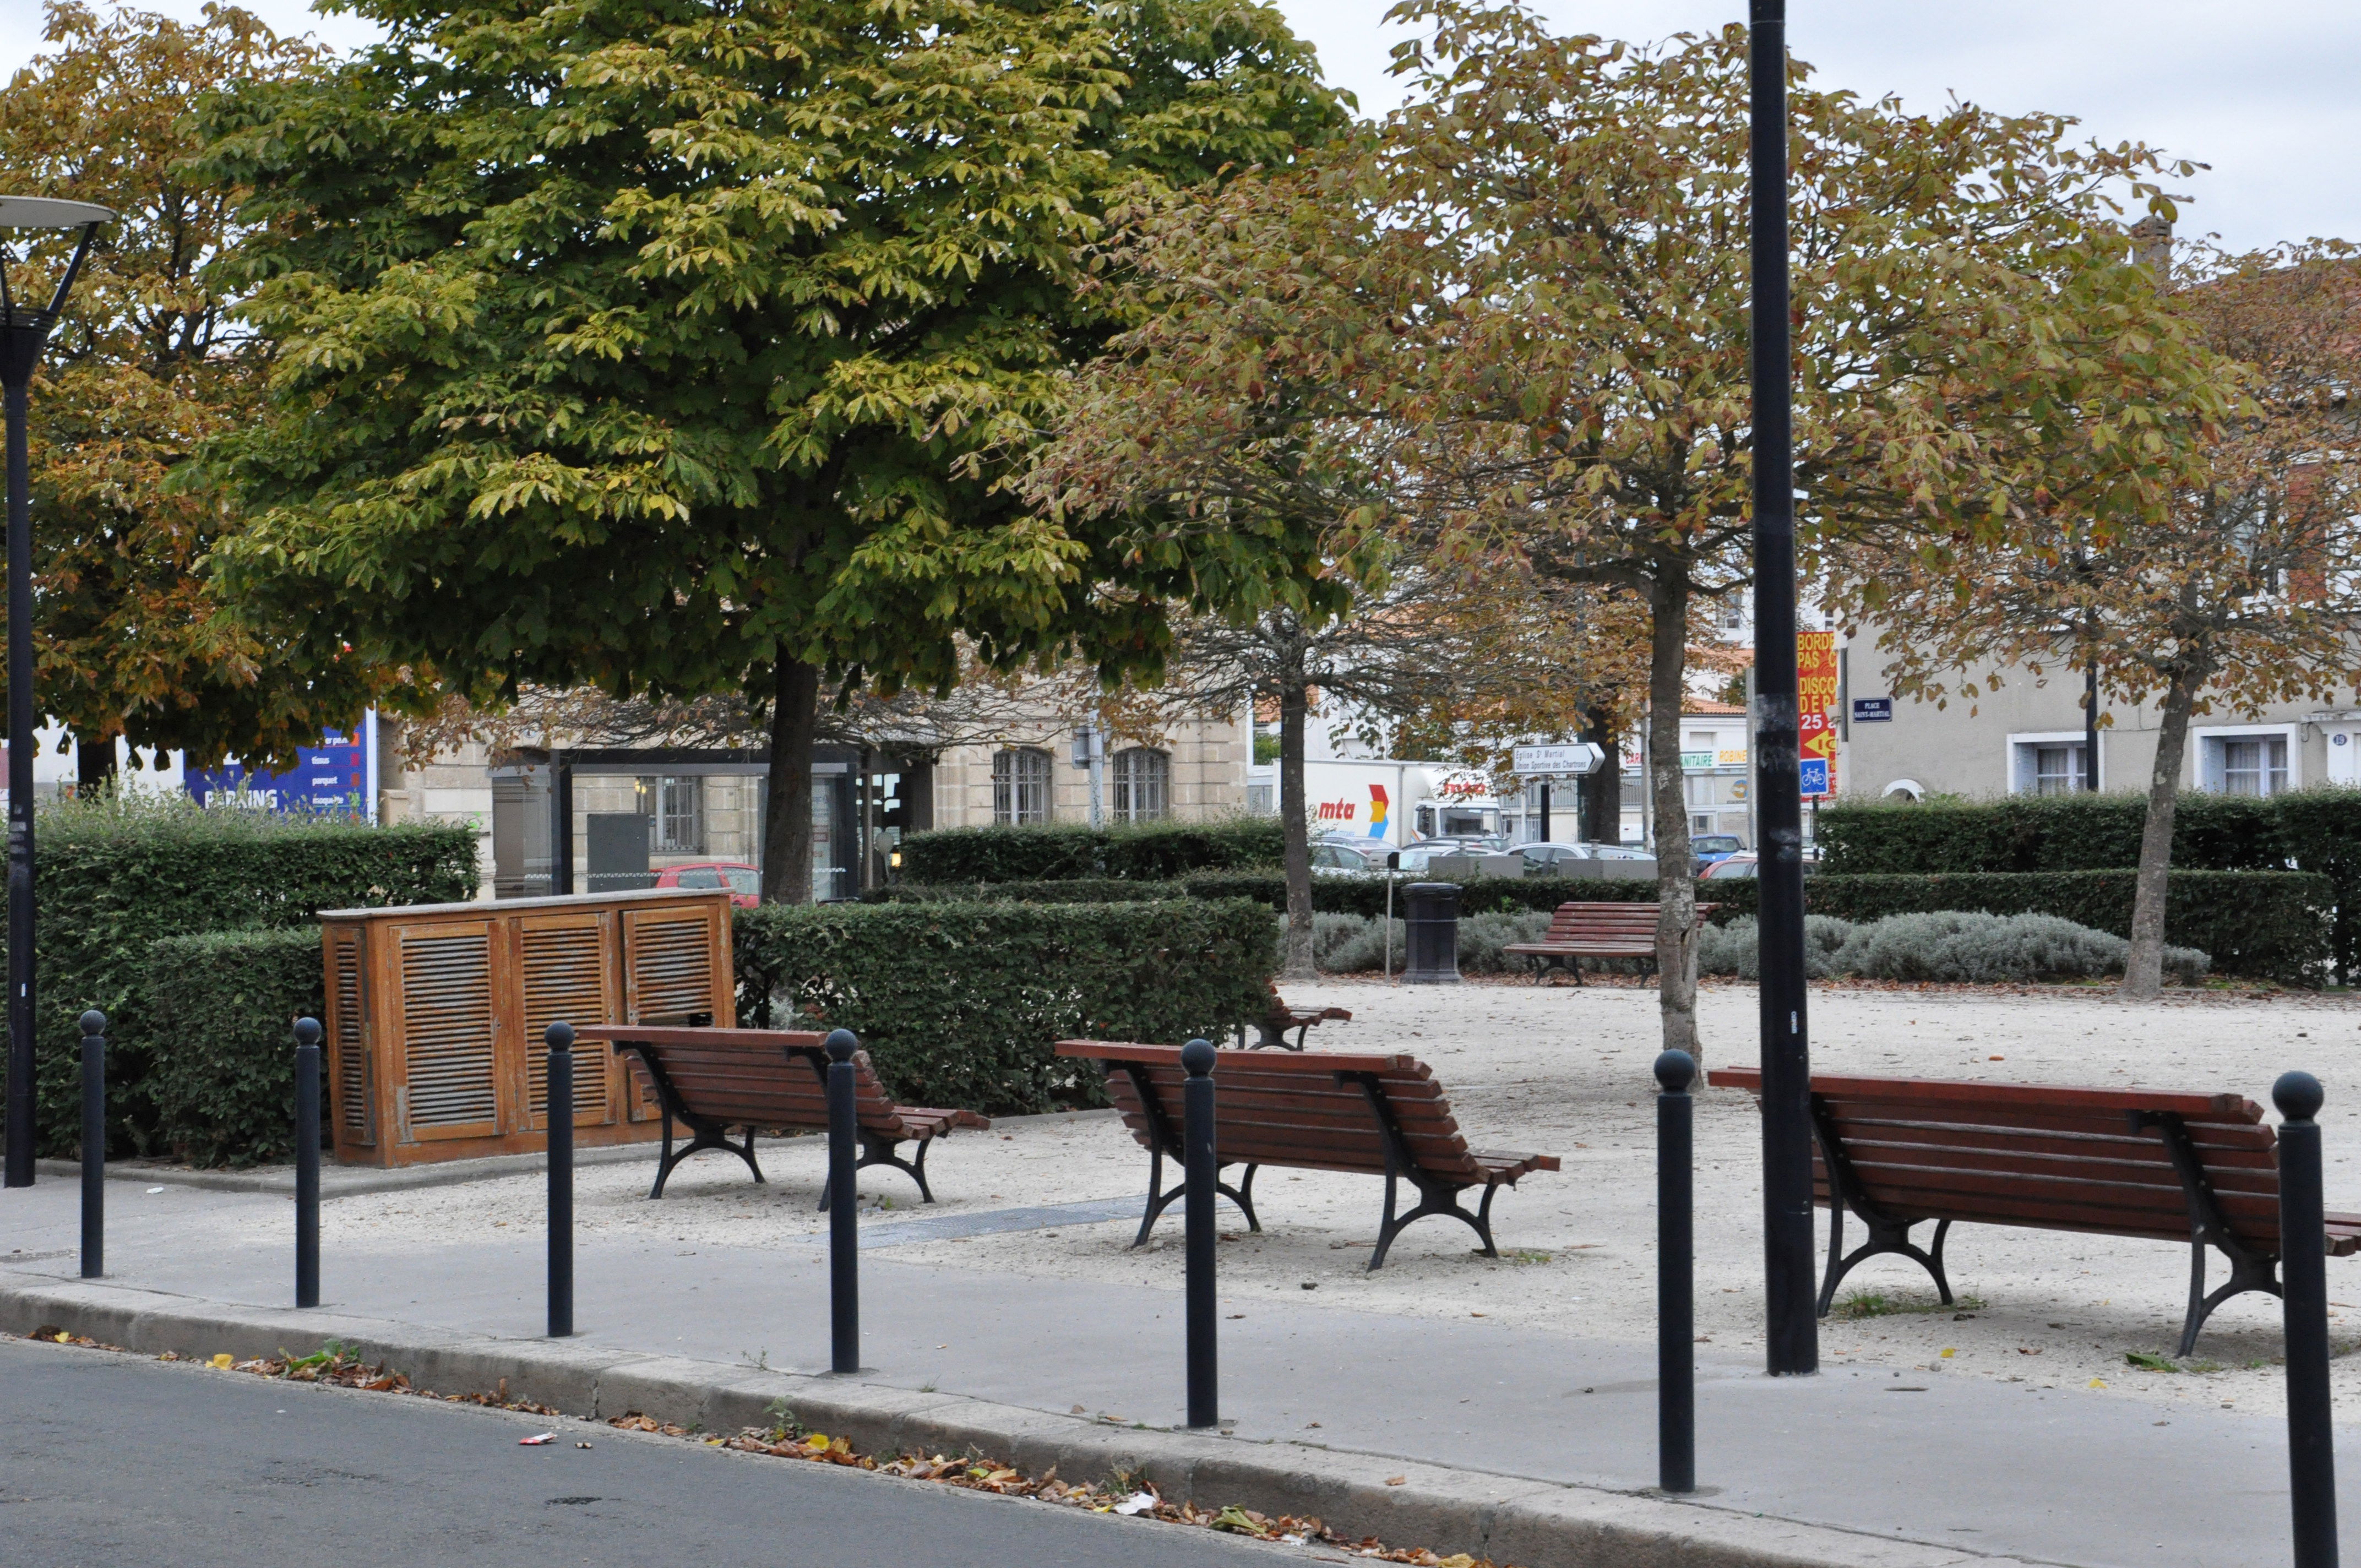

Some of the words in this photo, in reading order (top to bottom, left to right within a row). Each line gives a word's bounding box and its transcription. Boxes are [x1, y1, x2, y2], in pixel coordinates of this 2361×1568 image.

[1797, 650, 1819, 668] PAS
[1799, 677, 1836, 695] DISCO
[1800, 714, 1823, 729] 25
[2336, 736, 2345, 745] 19
[1544, 749, 1565, 758] Martial
[312, 756, 330, 765] tissus
[1516, 761, 1530, 770] Union
[1531, 760, 1551, 770] Sportive
[1553, 760, 1561, 769] des
[1562, 759, 1586, 769] Chartrons
[312, 776, 338, 787] parquet
[1319, 797, 1356, 820] mta
